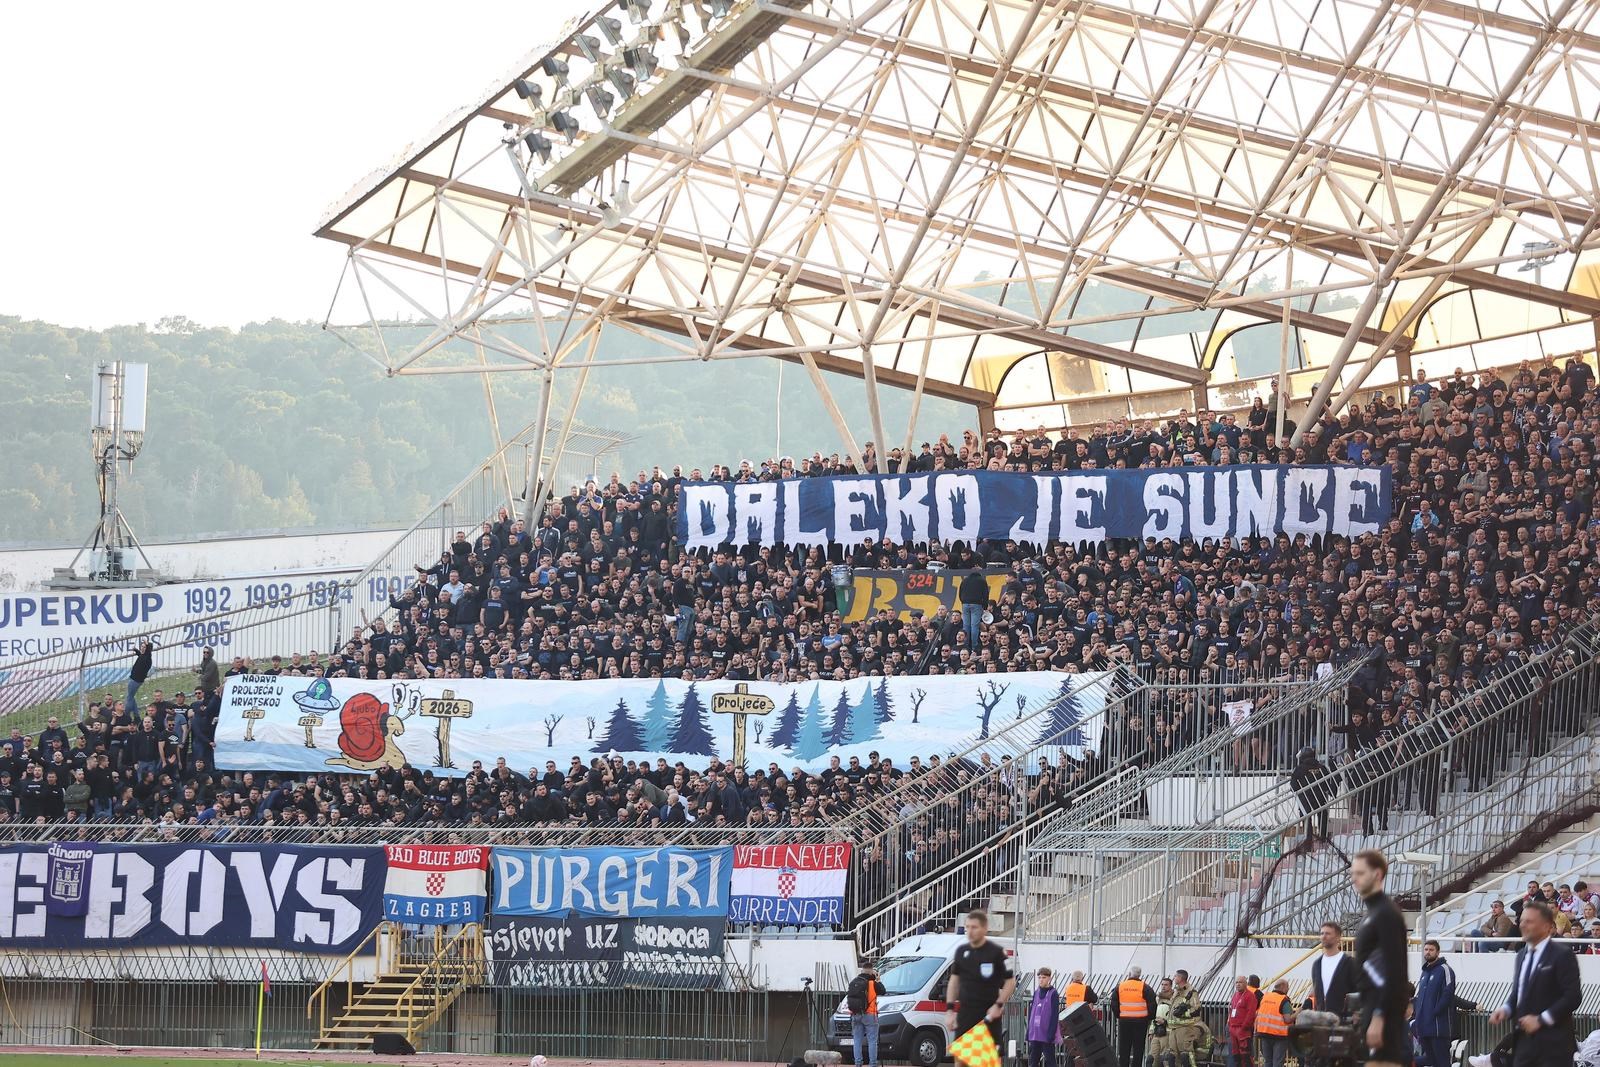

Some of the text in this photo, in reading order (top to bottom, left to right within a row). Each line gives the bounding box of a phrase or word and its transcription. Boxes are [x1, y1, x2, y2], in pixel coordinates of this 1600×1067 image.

[684, 468, 1382, 560] DALEKO JE SUNCE
[907, 574, 934, 589] 324
[184, 586, 231, 613] 1992
[245, 583, 292, 609] 1993
[306, 579, 353, 606] 1994
[70, 634, 162, 653] WINNERS
[183, 621, 231, 648] 2005
[242, 675, 277, 683] NAJAVA
[232, 684, 284, 696] PROLJEĆA U
[231, 697, 281, 707] HRVATSKOJ
[429, 702, 460, 714] 2026
[718, 697, 766, 711] Proljeće
[48, 843, 93, 859] dinamo
[418, 850, 451, 866] BLUE
[453, 848, 482, 865] BOYS
[784, 845, 846, 869] NEVER
[496, 851, 722, 916] PURGERI
[84, 850, 366, 946] BOYS
[389, 900, 472, 918] ZAGREB
[729, 897, 841, 924] SURRENDER
[493, 921, 619, 958] sjever uz
